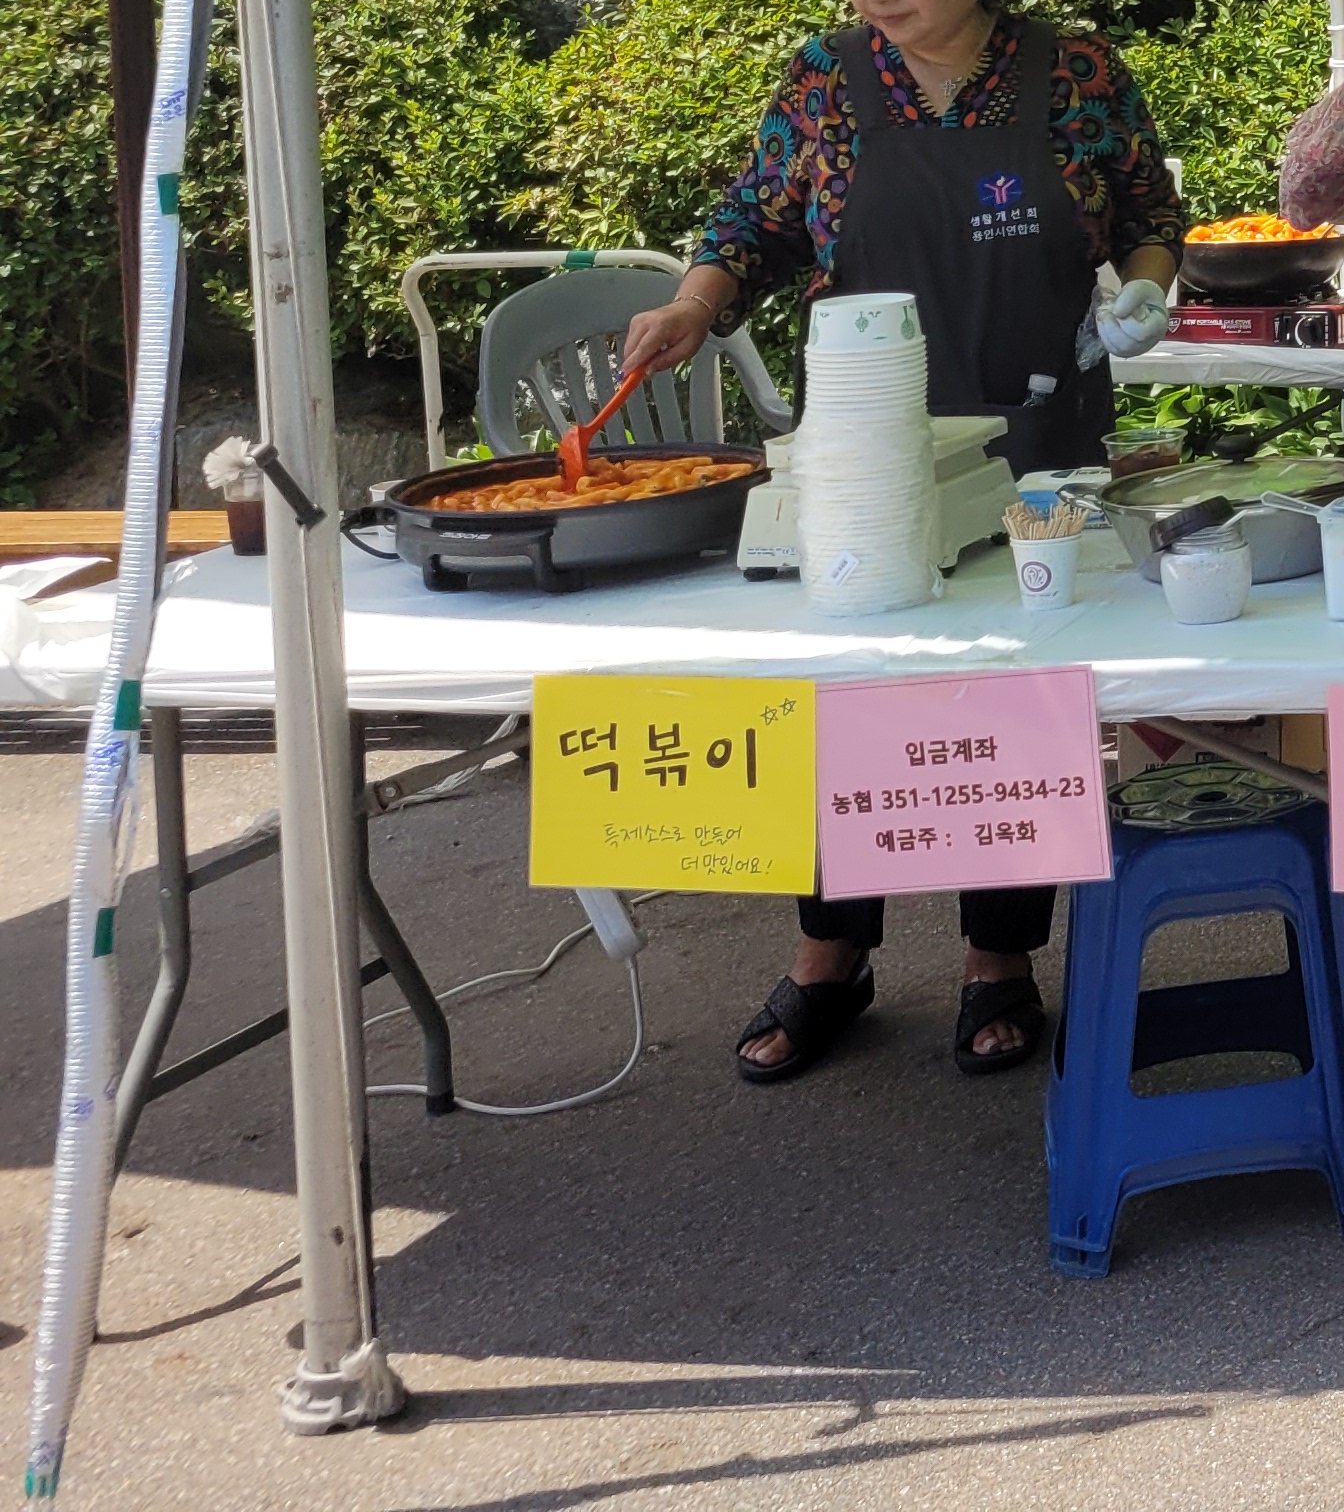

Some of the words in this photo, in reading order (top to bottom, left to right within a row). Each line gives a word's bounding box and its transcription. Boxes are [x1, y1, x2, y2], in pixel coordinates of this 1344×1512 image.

[559, 722, 757, 792] 떡볶이
[904, 735, 998, 769] 입금계좌
[831, 790, 874, 816] 농협
[881, 775, 1087, 812] 351-1255-9434-23
[874, 828, 939, 854] 예금주
[974, 819, 1038, 846] 김옥화
